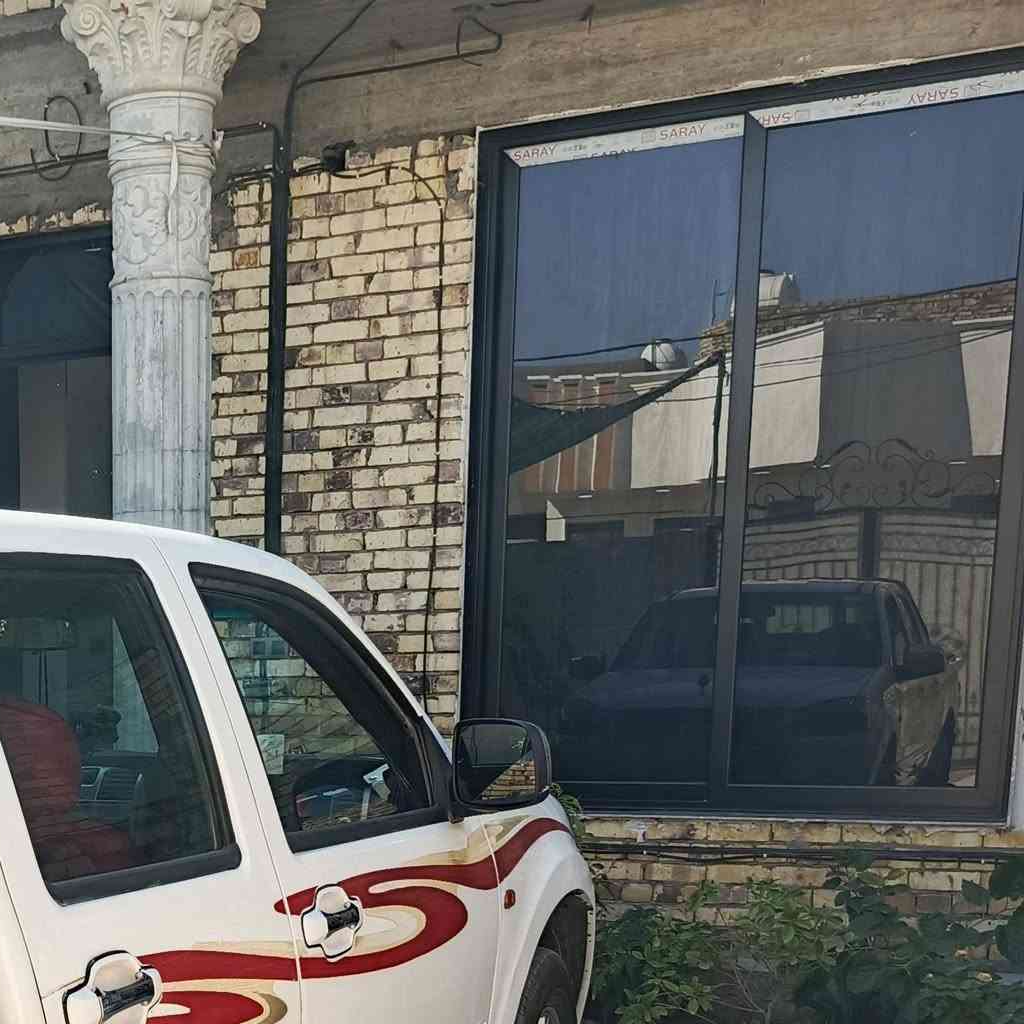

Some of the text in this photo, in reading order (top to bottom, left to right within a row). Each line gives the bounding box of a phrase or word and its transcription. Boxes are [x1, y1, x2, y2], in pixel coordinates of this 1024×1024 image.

[906, 86, 960, 105] SARAY
[659, 123, 707, 141] SARAY
[512, 143, 558, 162] SARAY
